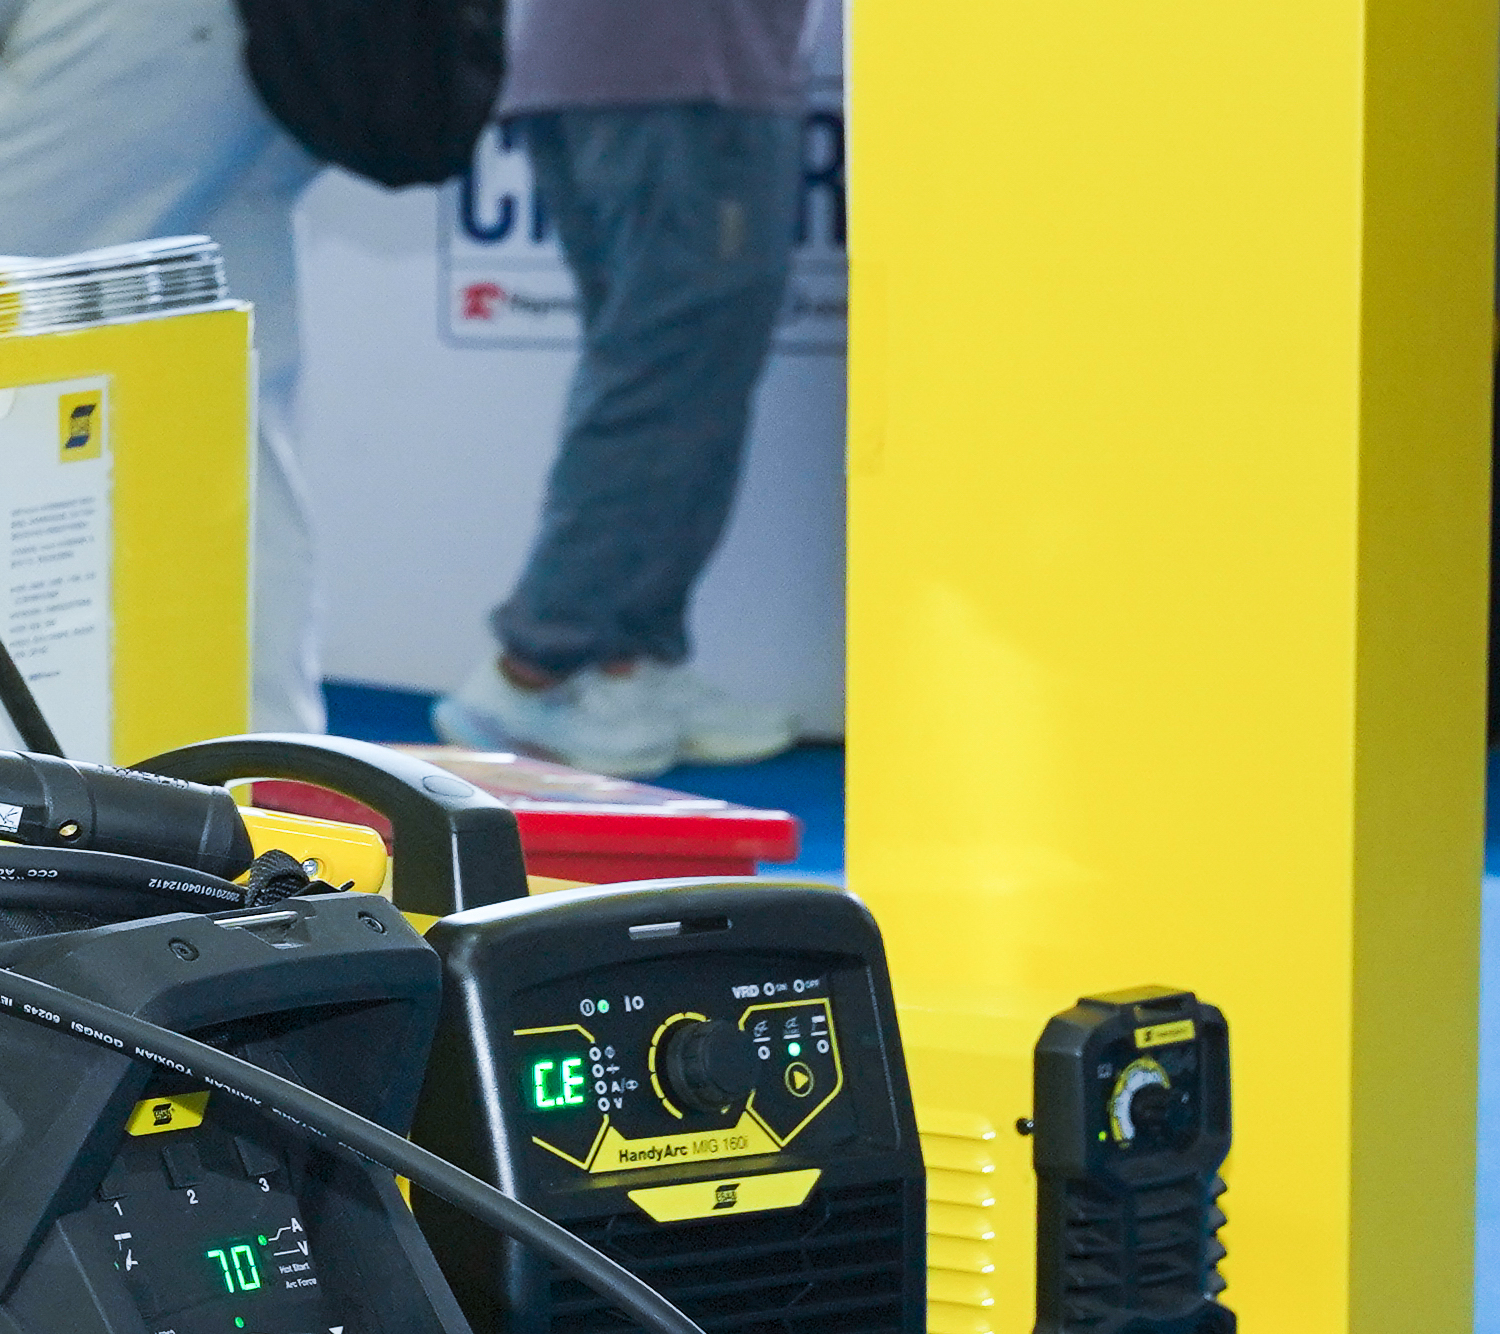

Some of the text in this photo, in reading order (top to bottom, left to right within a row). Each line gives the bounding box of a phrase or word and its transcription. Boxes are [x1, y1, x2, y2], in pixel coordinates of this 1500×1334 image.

[732, 983, 760, 999] VRD
[22, 1003, 61, 1025] 60245
[70, 1020, 124, 1049] GONGSI
[134, 1045, 194, 1077] YOUXIAN
[618, 1143, 688, 1164] HandyArc
[691, 1137, 719, 1157] MIG
[186, 1188, 199, 1206] 2
[258, 1176, 270, 1193] 3
[289, 1217, 302, 1234] A
[298, 1239, 310, 1256] V
[206, 1245, 263, 1293] 70
